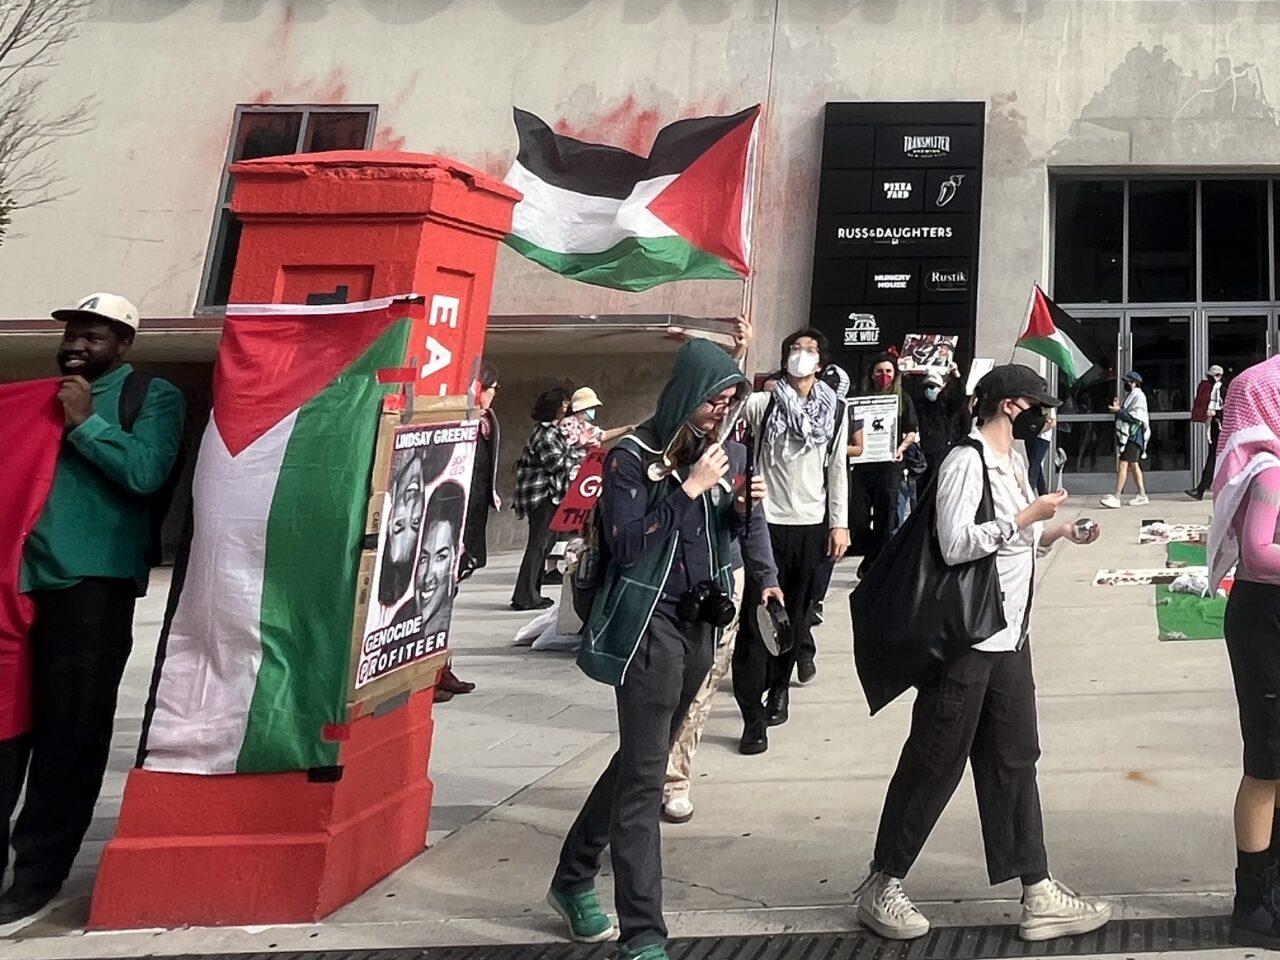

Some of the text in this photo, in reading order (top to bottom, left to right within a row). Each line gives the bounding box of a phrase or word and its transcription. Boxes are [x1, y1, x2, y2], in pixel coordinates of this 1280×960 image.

[904, 136, 950, 152] TRANSMITTER
[932, 272, 966, 282] Rustik
[844, 331, 880, 342] SHE WOLF
[395, 426, 477, 450] LINDSAY GREENE
[365, 616, 422, 653] GENOCIDE
[360, 632, 446, 682] PROFITEER
